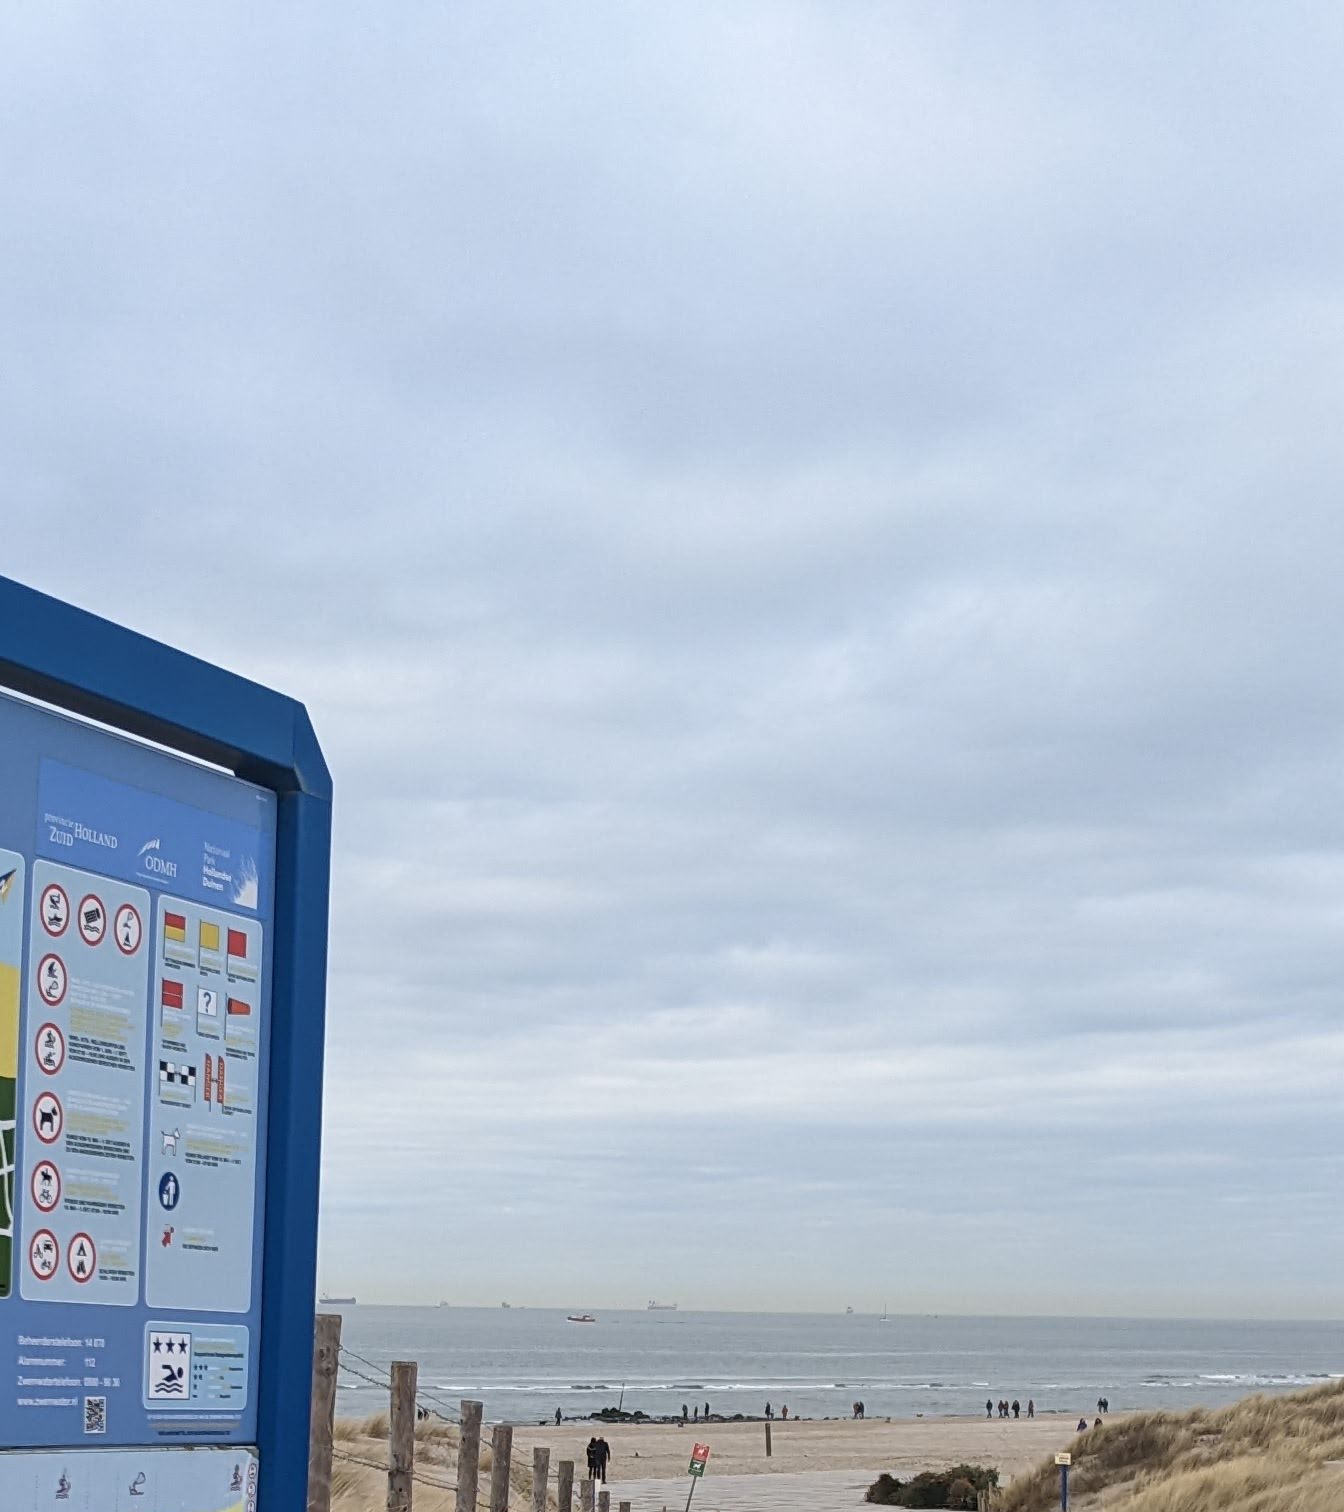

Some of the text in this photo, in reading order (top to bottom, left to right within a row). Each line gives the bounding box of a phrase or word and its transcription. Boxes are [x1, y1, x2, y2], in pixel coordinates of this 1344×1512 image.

[49, 826, 73, 846] ZUID
[75, 822, 118, 849] HOLLAND
[146, 855, 177, 878] ODMH
